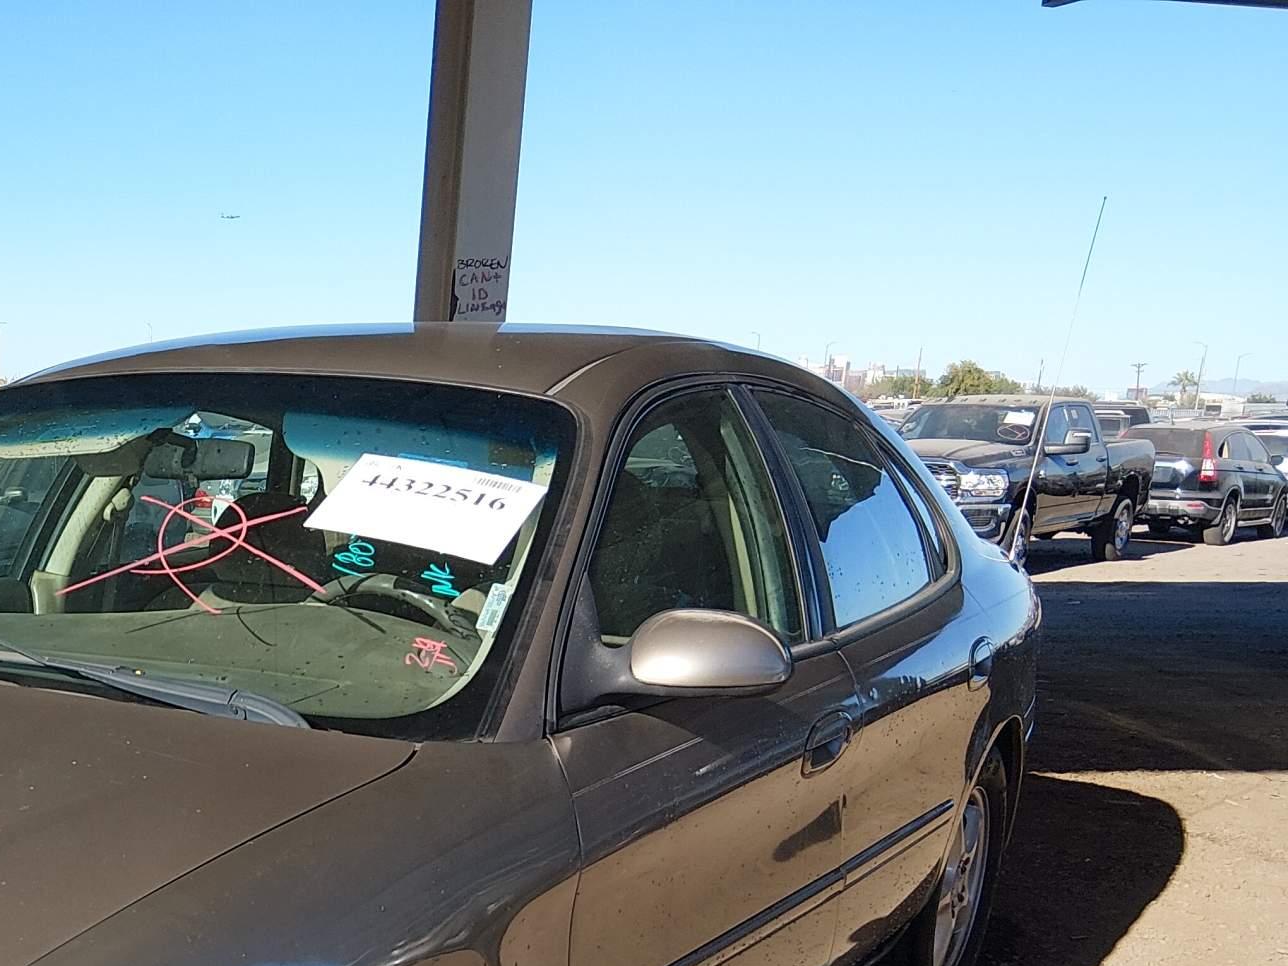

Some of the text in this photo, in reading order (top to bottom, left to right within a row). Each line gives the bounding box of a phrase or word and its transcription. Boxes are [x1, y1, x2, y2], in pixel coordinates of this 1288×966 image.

[457, 256, 509, 270] BROKEN
[472, 288, 489, 301] ID
[362, 474, 506, 511] 44322516
